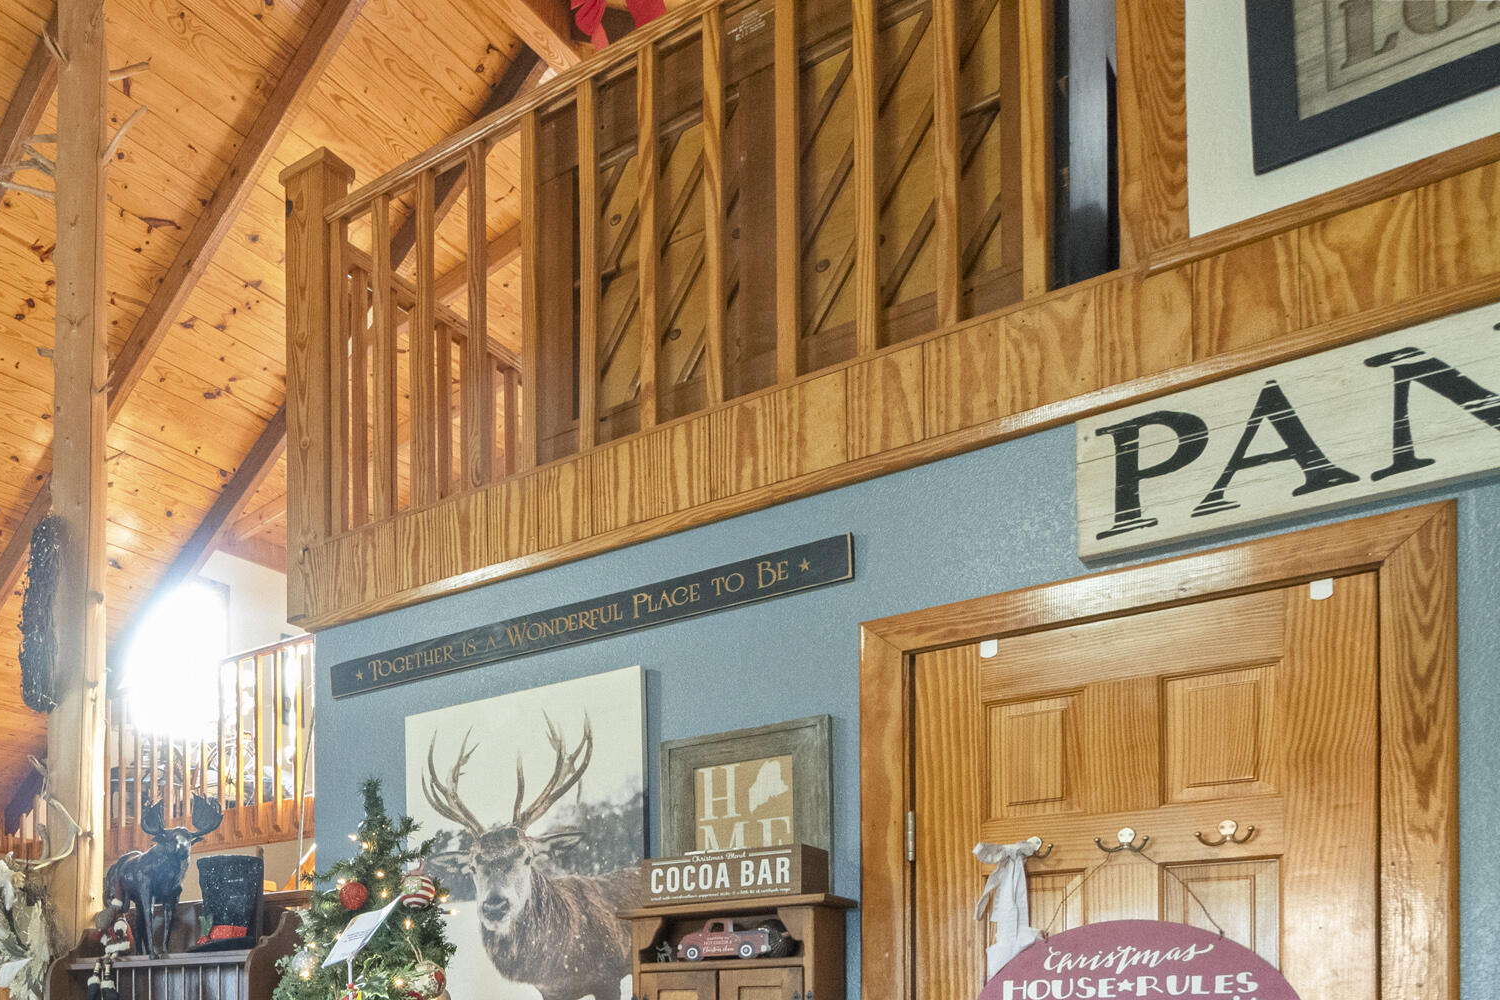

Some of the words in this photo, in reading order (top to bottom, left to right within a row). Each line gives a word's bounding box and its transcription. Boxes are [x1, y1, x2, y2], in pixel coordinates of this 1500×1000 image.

[368, 645, 460, 681] TOGETHER
[462, 638, 477, 657] IS
[485, 636, 498, 651] A
[506, 603, 623, 648] WONDERFUL
[632, 583, 700, 619] PLACE
[710, 572, 745, 597] TO
[756, 560, 789, 589] BE
[651, 862, 731, 894] COCOA
[740, 857, 791, 886] BAR
[1043, 943, 1214, 974] Christmas
[1002, 976, 1117, 1000] HOUSE
[1135, 972, 1259, 997] RULES
